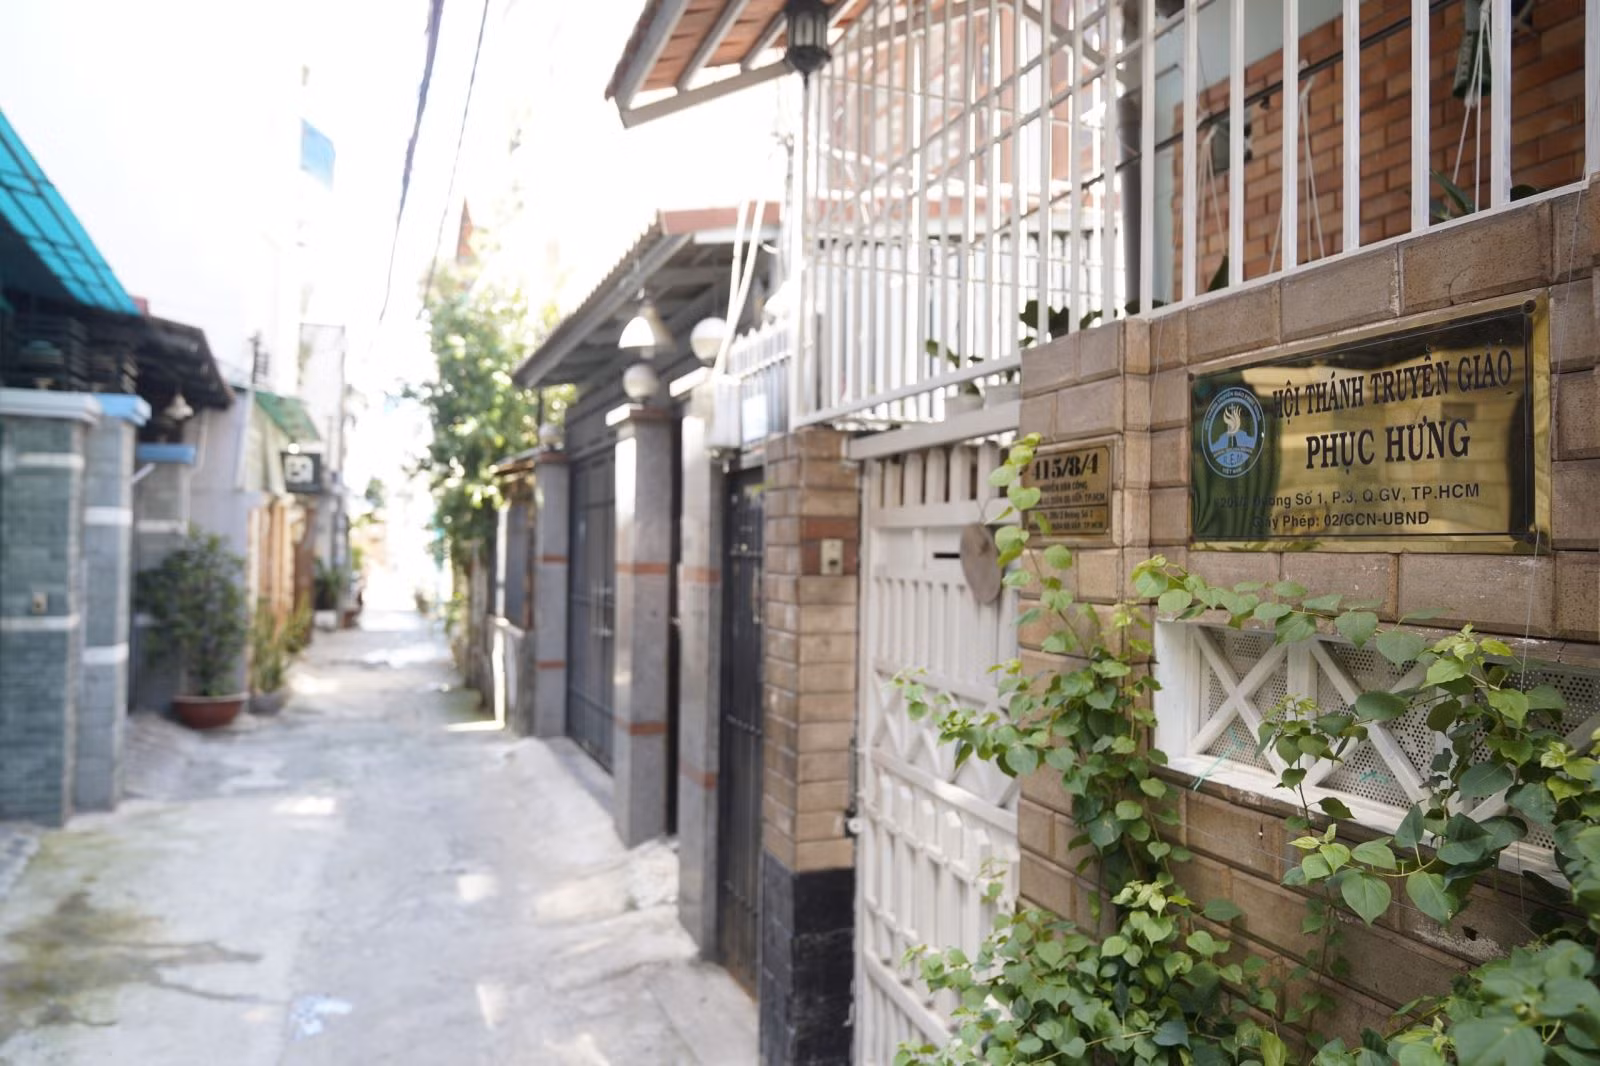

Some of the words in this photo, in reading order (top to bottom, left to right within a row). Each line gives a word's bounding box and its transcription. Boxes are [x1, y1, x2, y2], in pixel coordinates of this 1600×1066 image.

[1273, 379, 1300, 425] HỘI
[1305, 370, 1364, 415] THÁNH
[1306, 428, 1375, 475] PHỤC
[1385, 415, 1471, 463] HƯNG
[1032, 453, 1098, 480] 415/8/4
[1295, 490, 1312, 505] Số
[1411, 482, 1479, 501] TP.HCM
[1283, 513, 1320, 529] Phép:
[1324, 511, 1430, 527] 02/GCN-UBND
